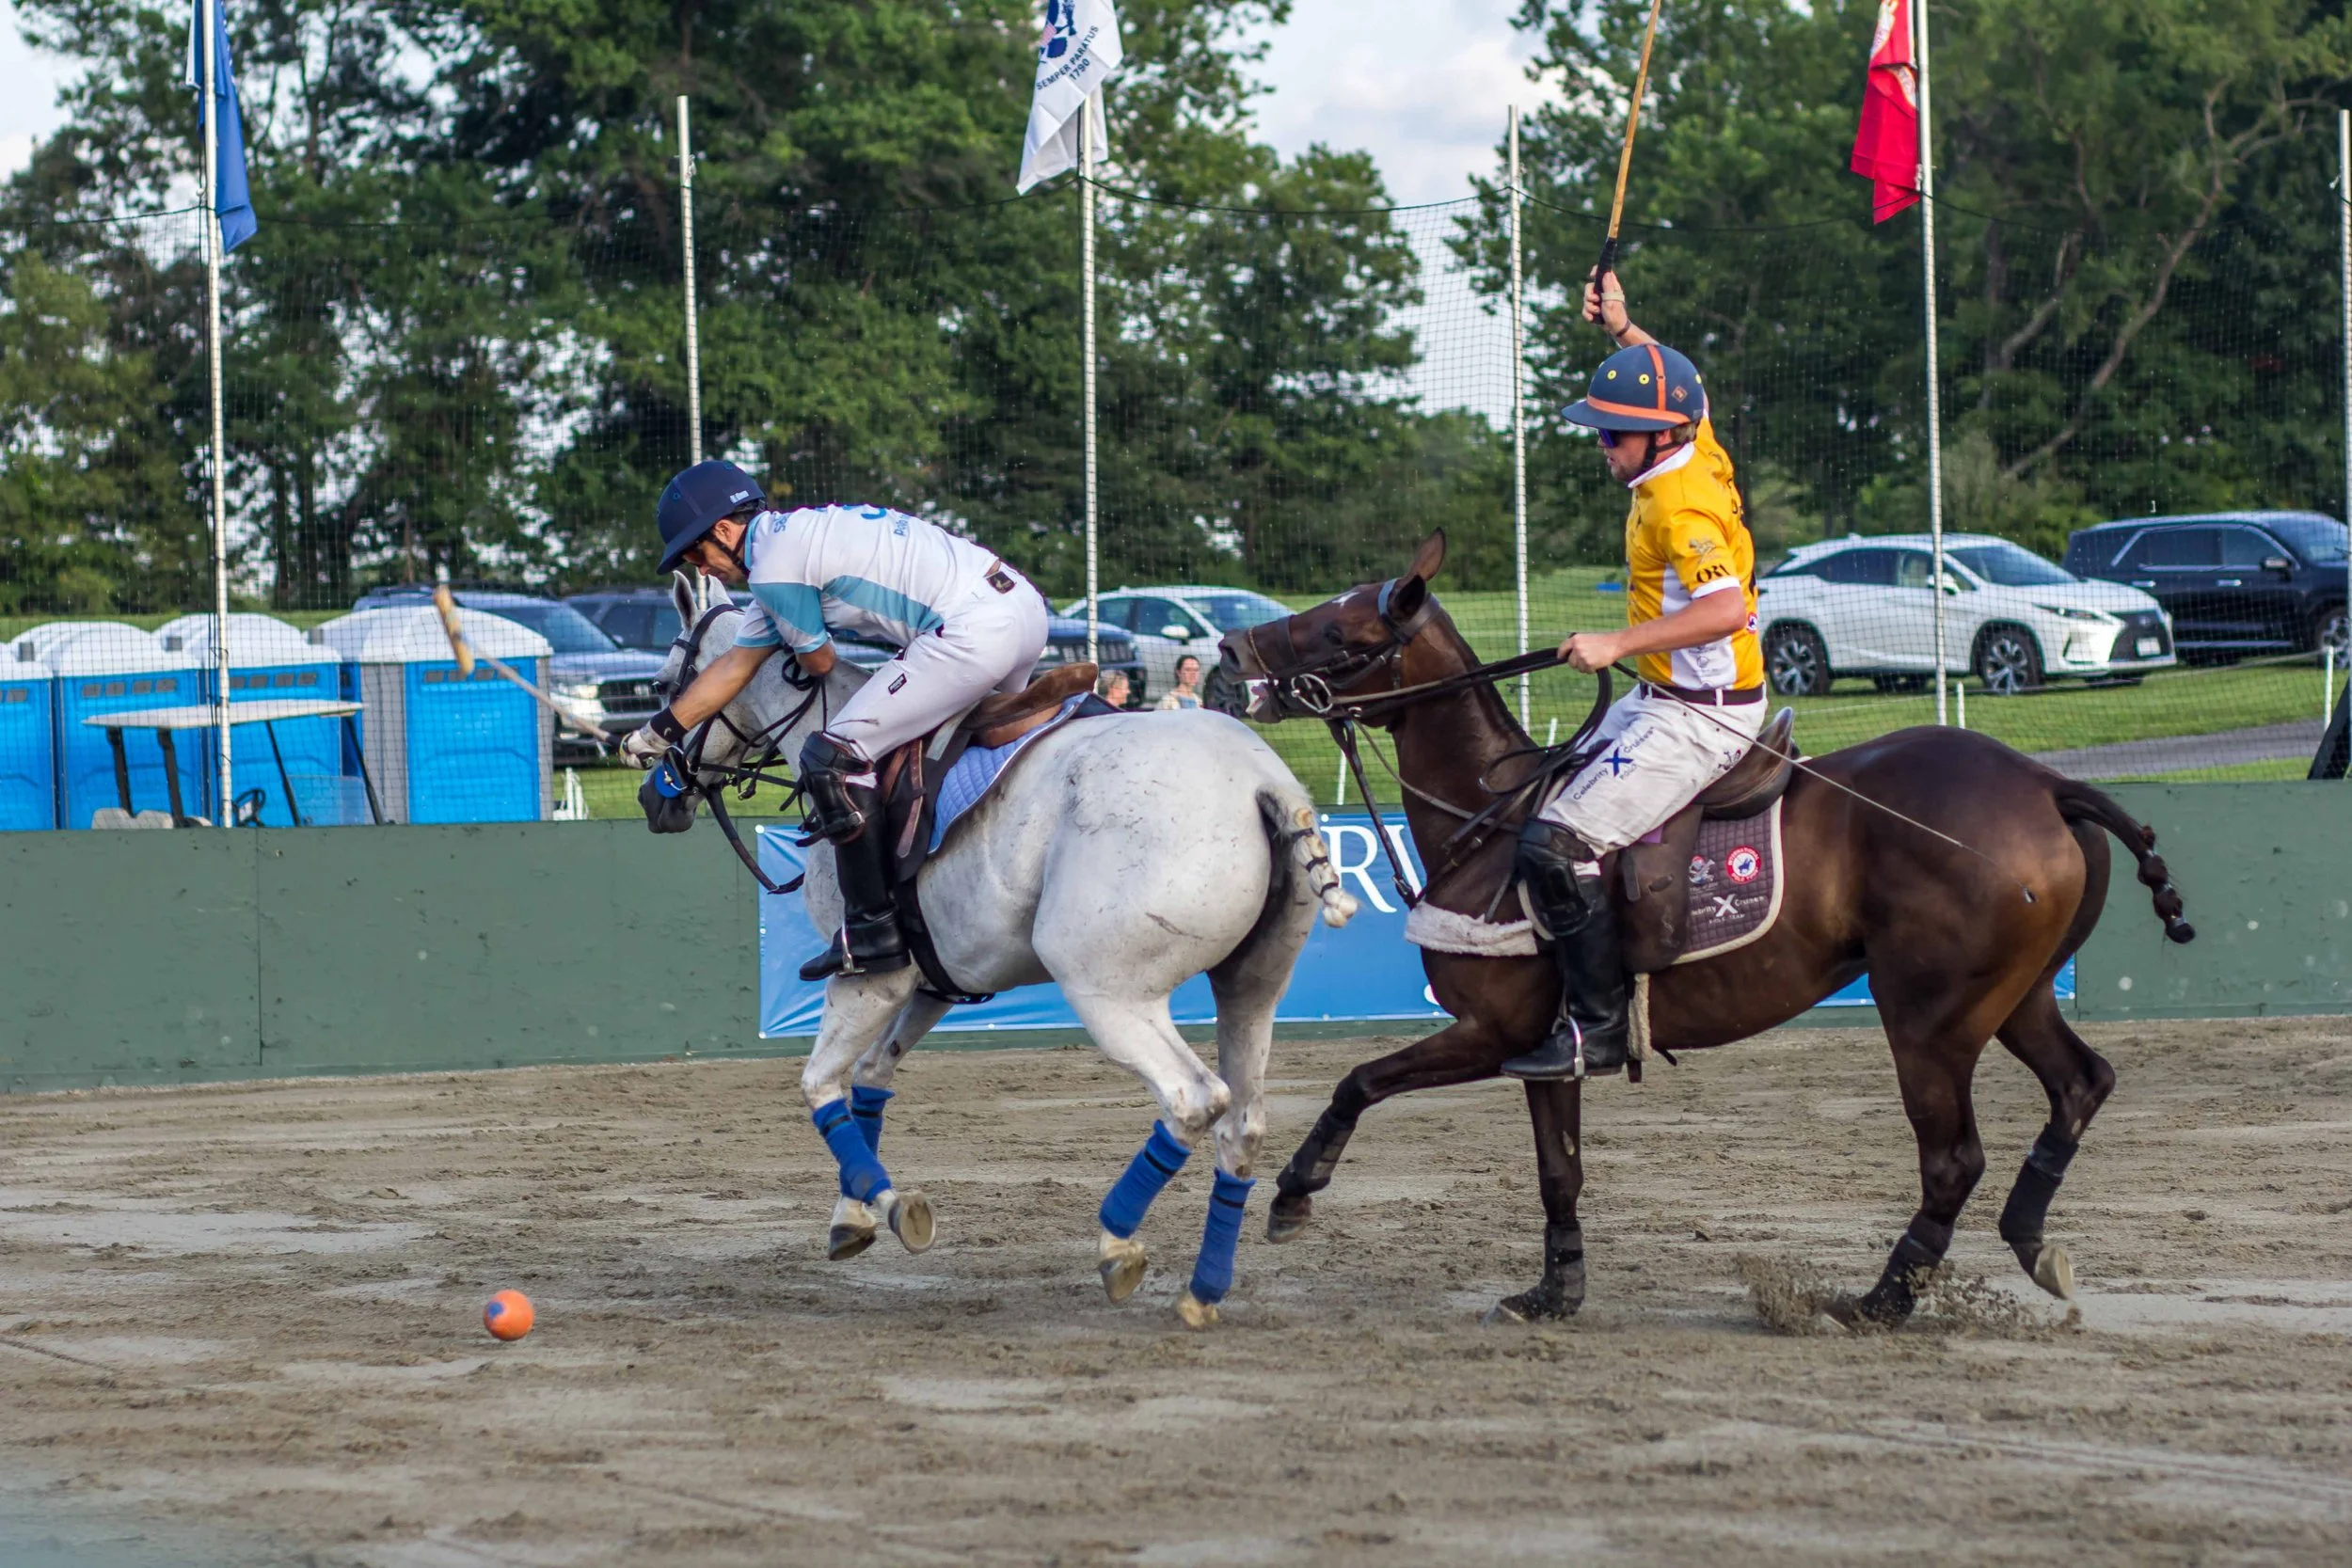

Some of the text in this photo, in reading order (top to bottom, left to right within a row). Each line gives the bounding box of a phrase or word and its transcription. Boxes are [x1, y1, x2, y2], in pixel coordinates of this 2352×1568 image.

[1036, 25, 1100, 90] SEMPER PARATUS
[1069, 58, 1090, 81] 1790
[1573, 768, 1609, 800] Celebrity
[1623, 728, 1654, 753] Cruises
